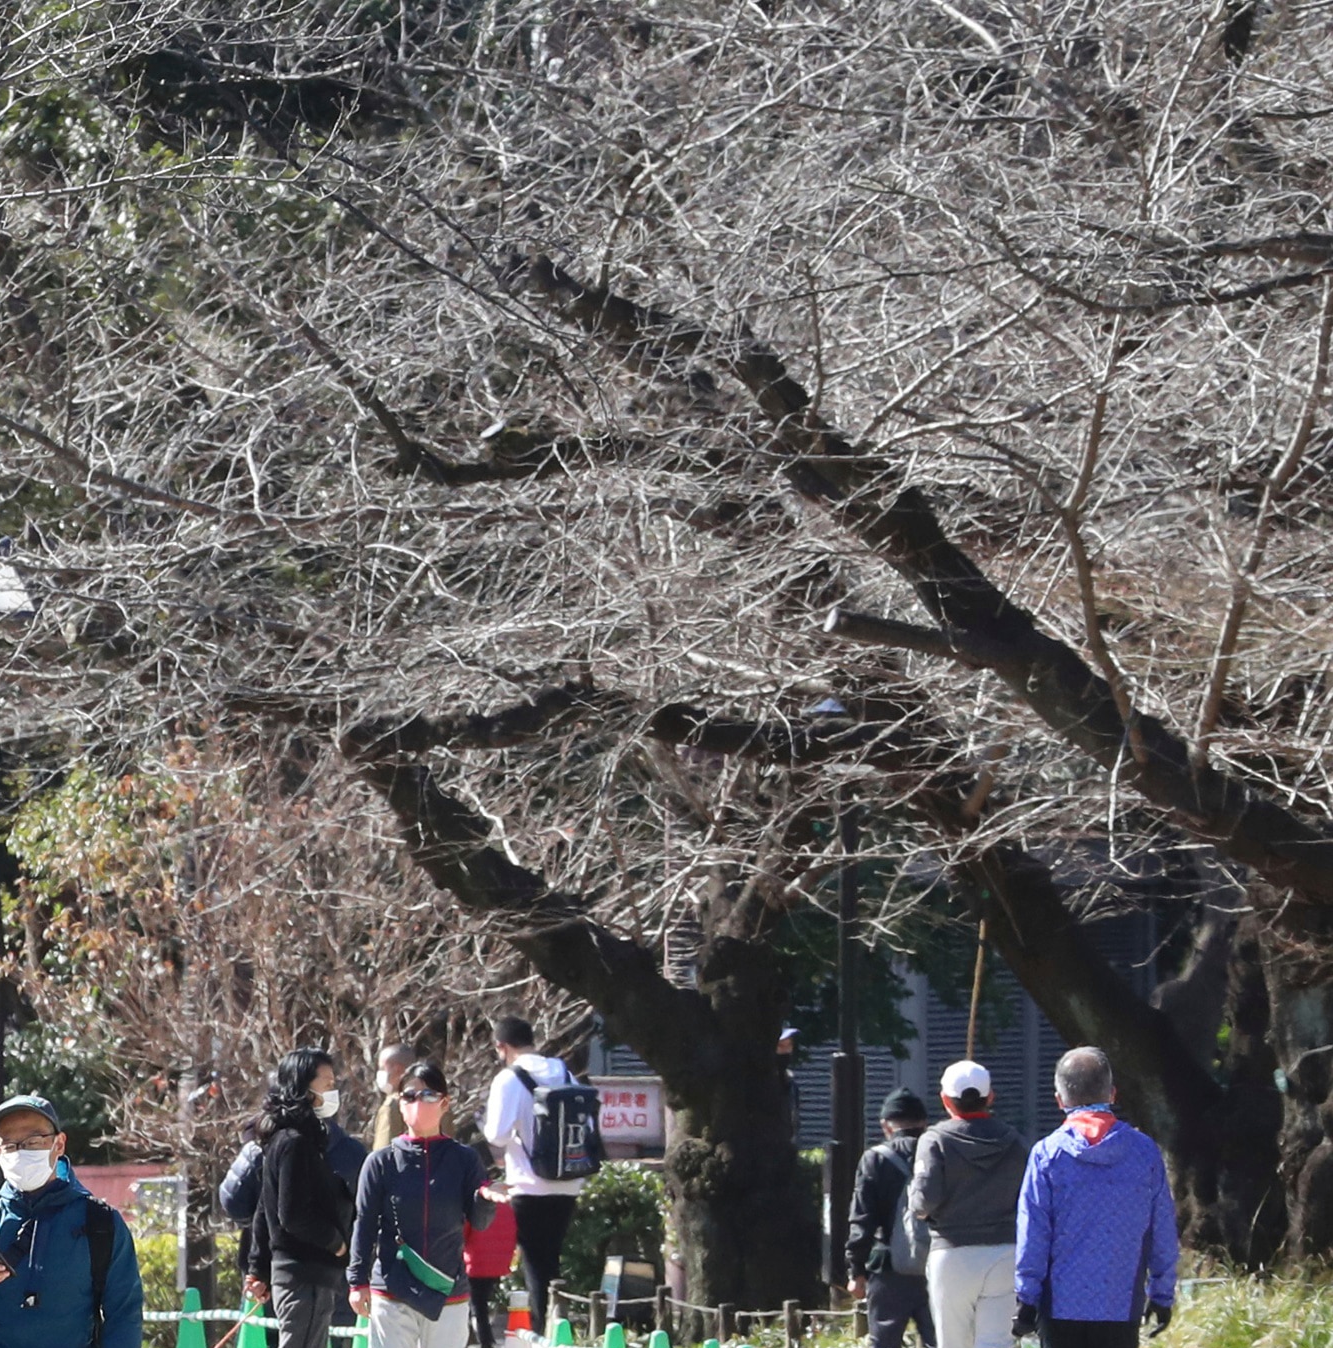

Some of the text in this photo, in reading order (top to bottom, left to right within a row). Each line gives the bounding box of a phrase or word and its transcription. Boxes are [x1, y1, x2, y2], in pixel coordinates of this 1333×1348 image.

[603, 1091, 647, 1107] 利用者
[603, 1112, 647, 1127] 出入口
